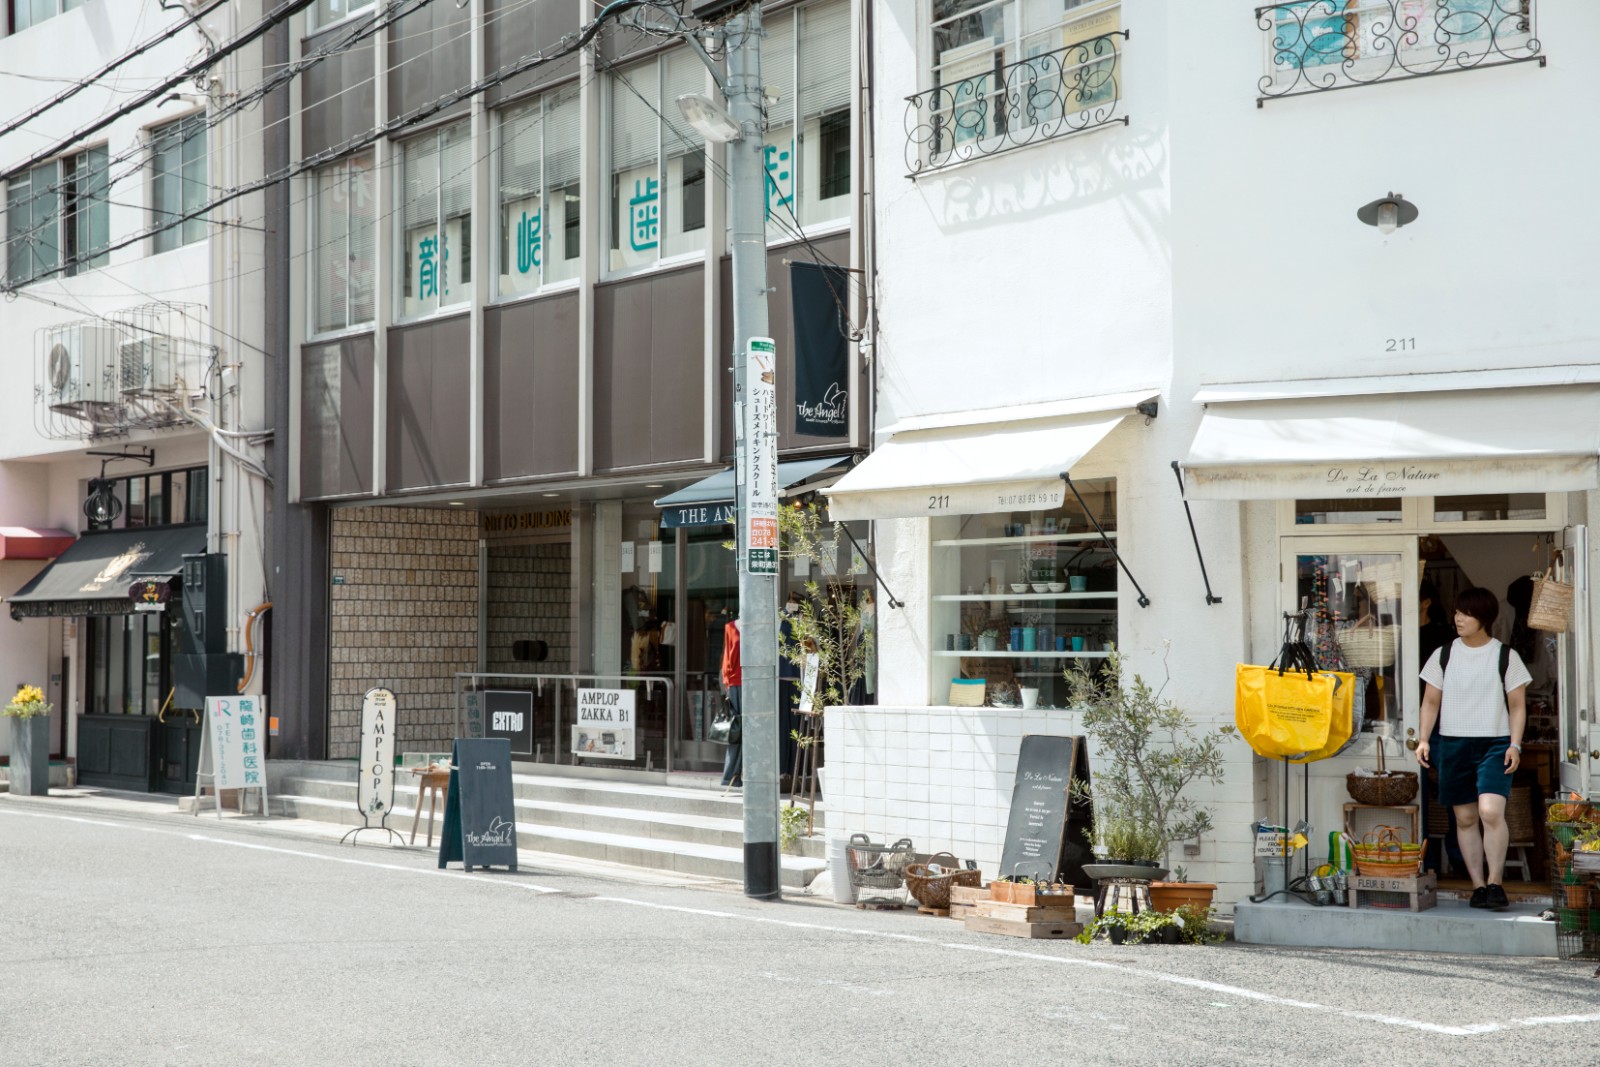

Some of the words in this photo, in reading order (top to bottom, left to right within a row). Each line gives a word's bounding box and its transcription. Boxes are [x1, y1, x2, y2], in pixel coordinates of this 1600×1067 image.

[1385, 337, 1416, 352] 211
[796, 400, 814, 418] The
[813, 402, 841, 422] Angel
[1326, 467, 1349, 483] De
[1356, 465, 1379, 482] La
[1385, 465, 1441, 482] Nature
[1346, 484, 1362, 494] art
[1364, 483, 1375, 494] de
[1376, 482, 1407, 496] france
[928, 494, 950, 510] 211
[484, 510, 518, 532] NITTO
[519, 509, 572, 530] BUILDING
[679, 507, 707, 525] THE
[751, 551, 771, 559] ここは
[581, 692, 620, 706] AMPLOP
[581, 708, 613, 722] ZAKKA
[618, 709, 629, 722] B1
[224, 722, 232, 743] TEL
[239, 699, 260, 784] 龍崎歯科医院
[372, 709, 385, 790] AMPLOP
[465, 831, 479, 845] The
[480, 831, 504, 845] Angel
